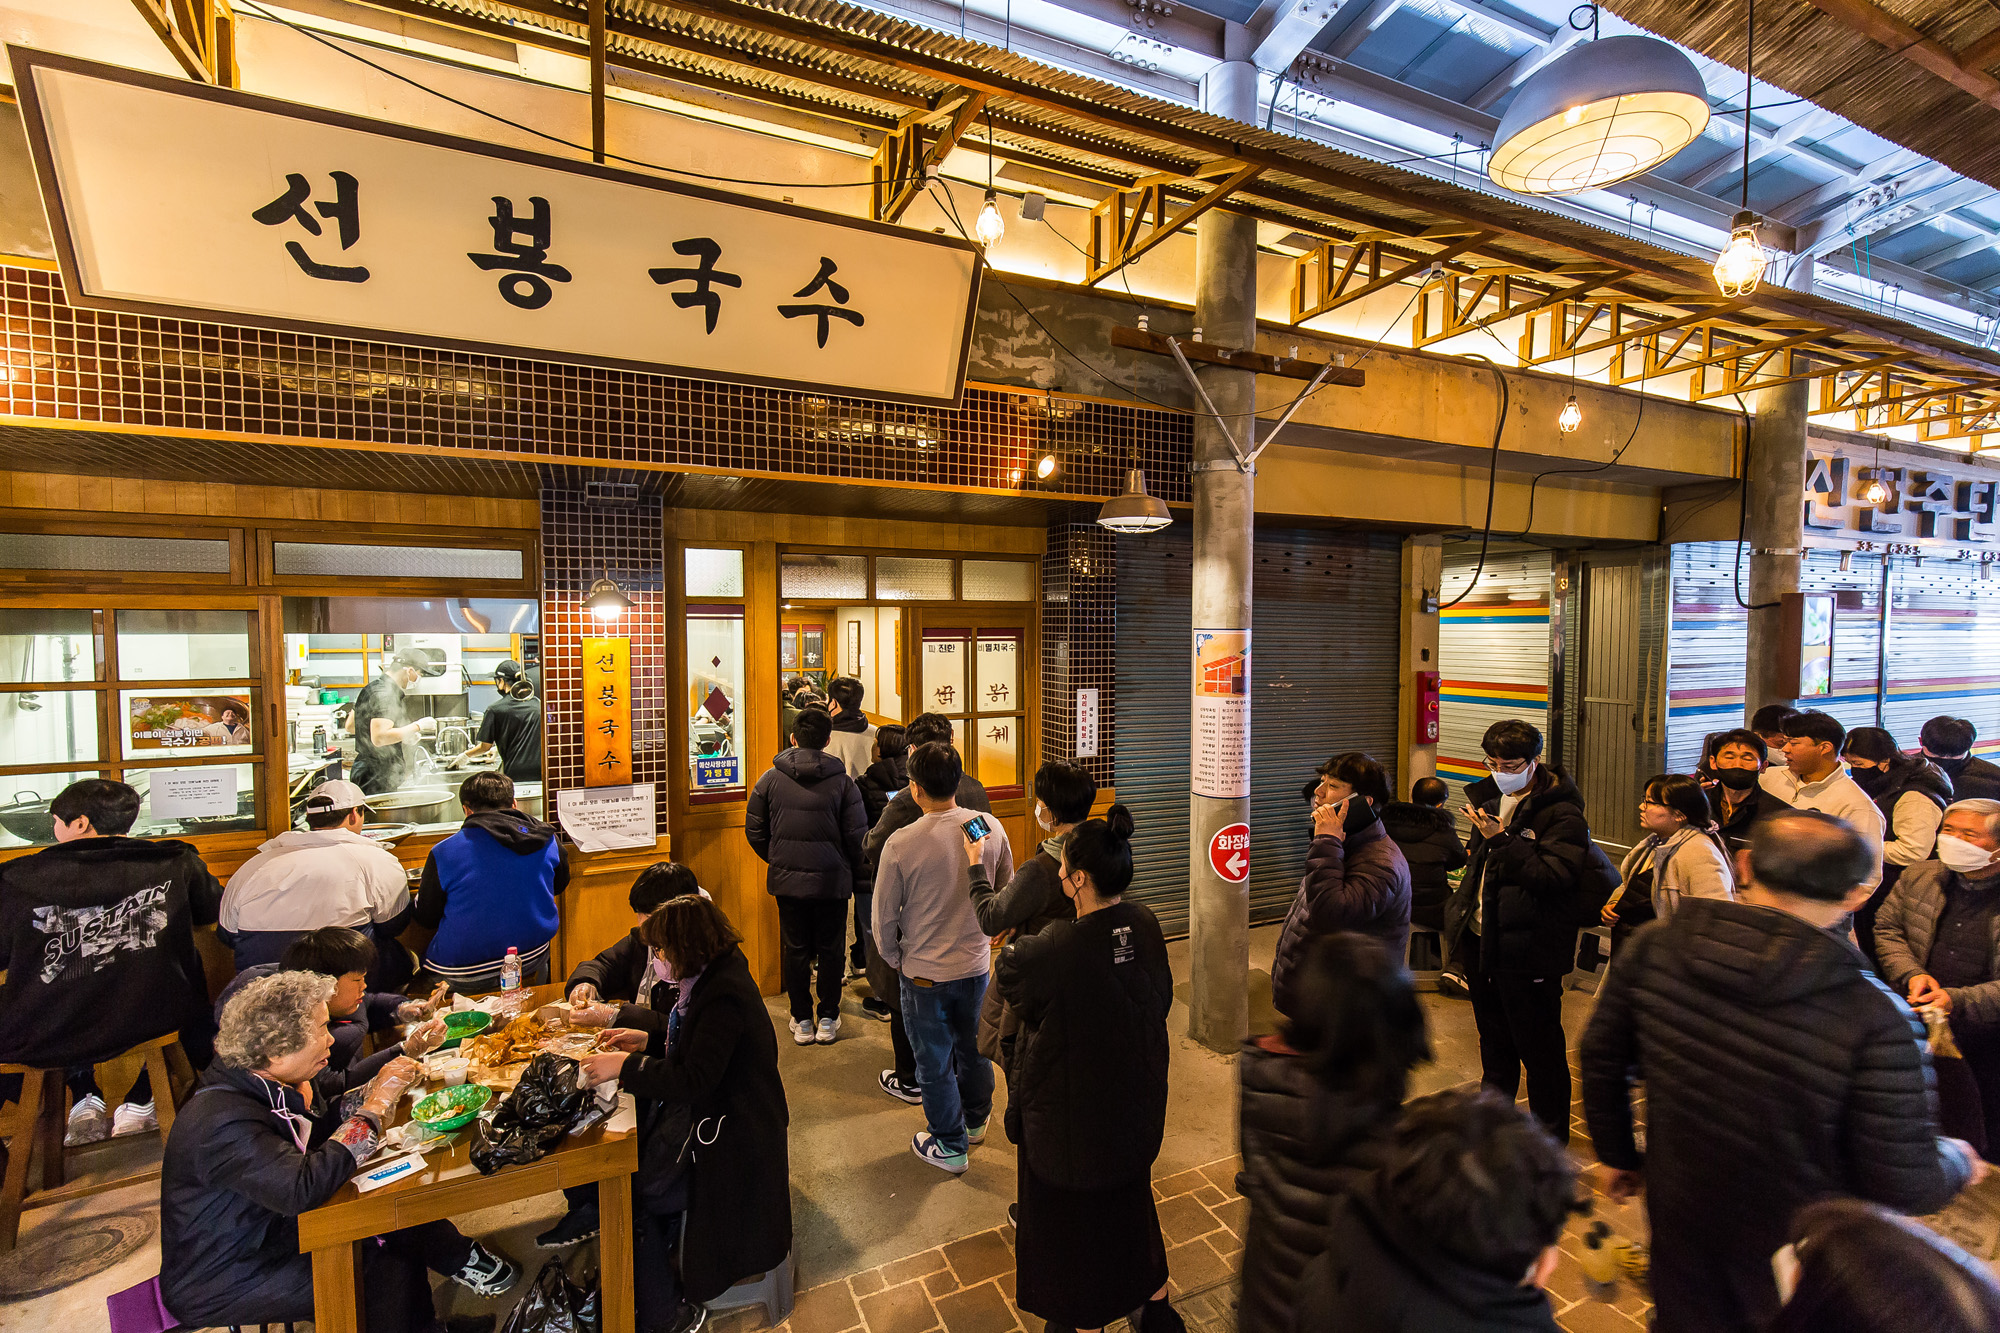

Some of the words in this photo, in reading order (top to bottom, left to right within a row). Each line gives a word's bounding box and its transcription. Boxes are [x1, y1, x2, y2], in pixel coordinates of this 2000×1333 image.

[250, 169, 866, 350] 선봉국수
[160, 737, 197, 747] 국수가
[595, 653, 621, 770] 선봉국수
[704, 768, 731, 778] 가맹점
[44, 880, 172, 966] SUSTAIN
